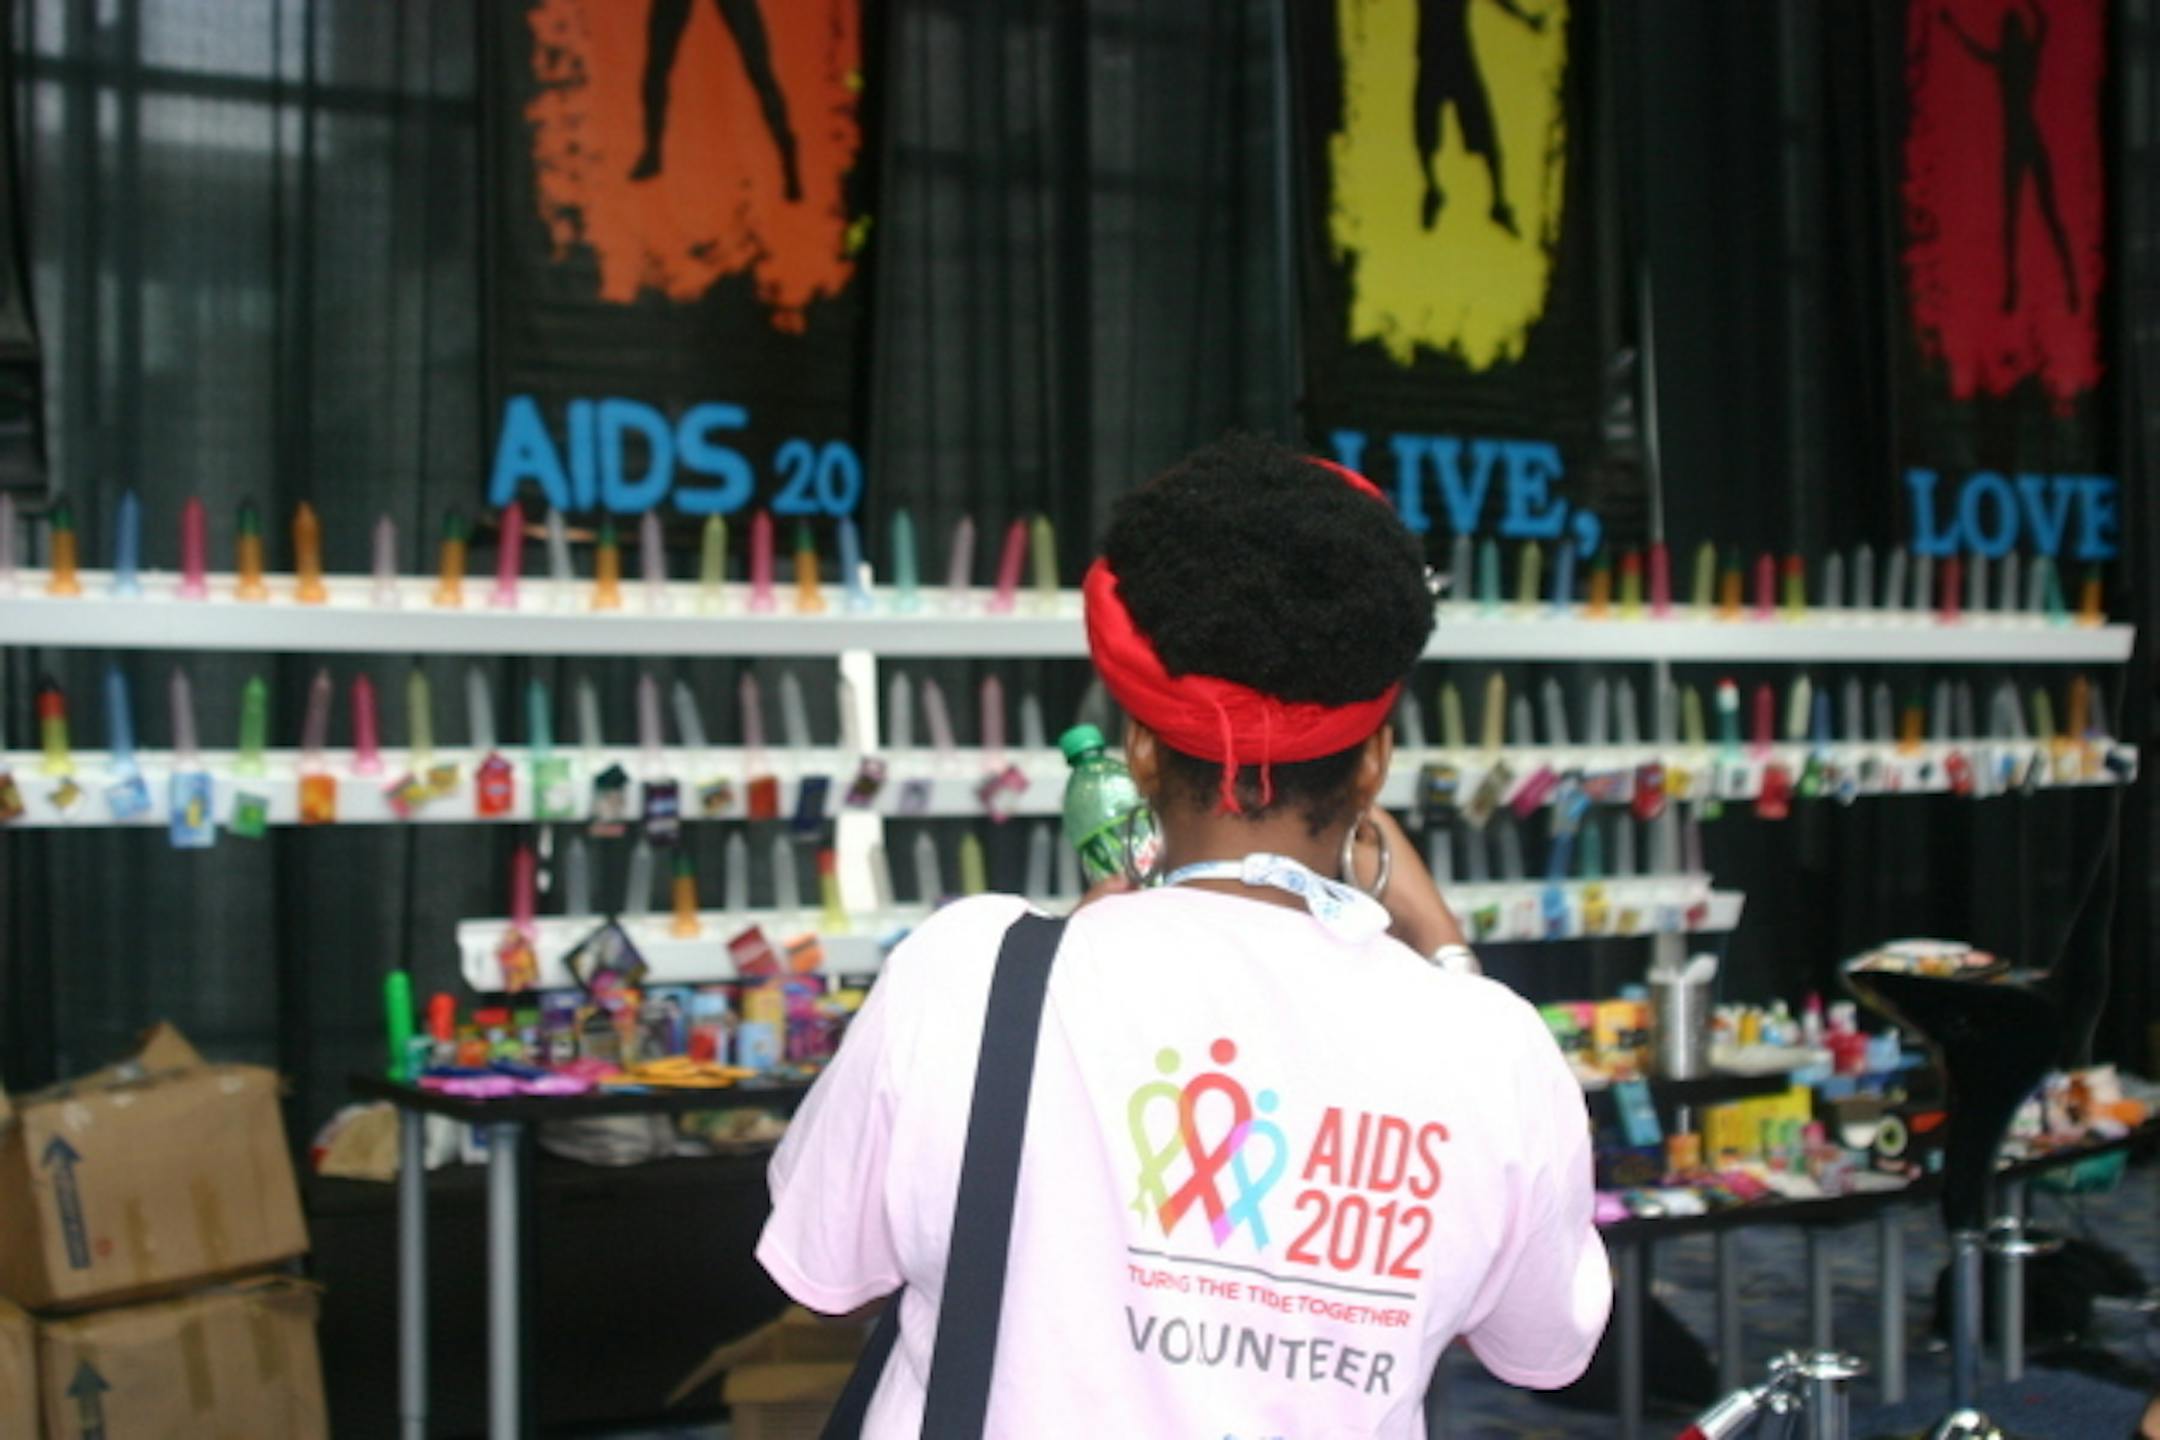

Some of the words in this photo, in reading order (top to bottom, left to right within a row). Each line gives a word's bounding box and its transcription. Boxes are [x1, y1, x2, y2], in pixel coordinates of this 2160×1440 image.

[489, 395, 753, 514] AIDS
[771, 440, 862, 516] 20
[1905, 467, 2119, 559] LOVE
[1302, 1106, 1451, 1199] AIDS
[1286, 1189, 1434, 1279] 2012
[1197, 1275, 1241, 1300] THE
[1247, 1285, 1292, 1313] TIDE
[1298, 1295, 1411, 1327] TOGETHER
[1125, 1305, 1395, 1395] VOUNTEER
